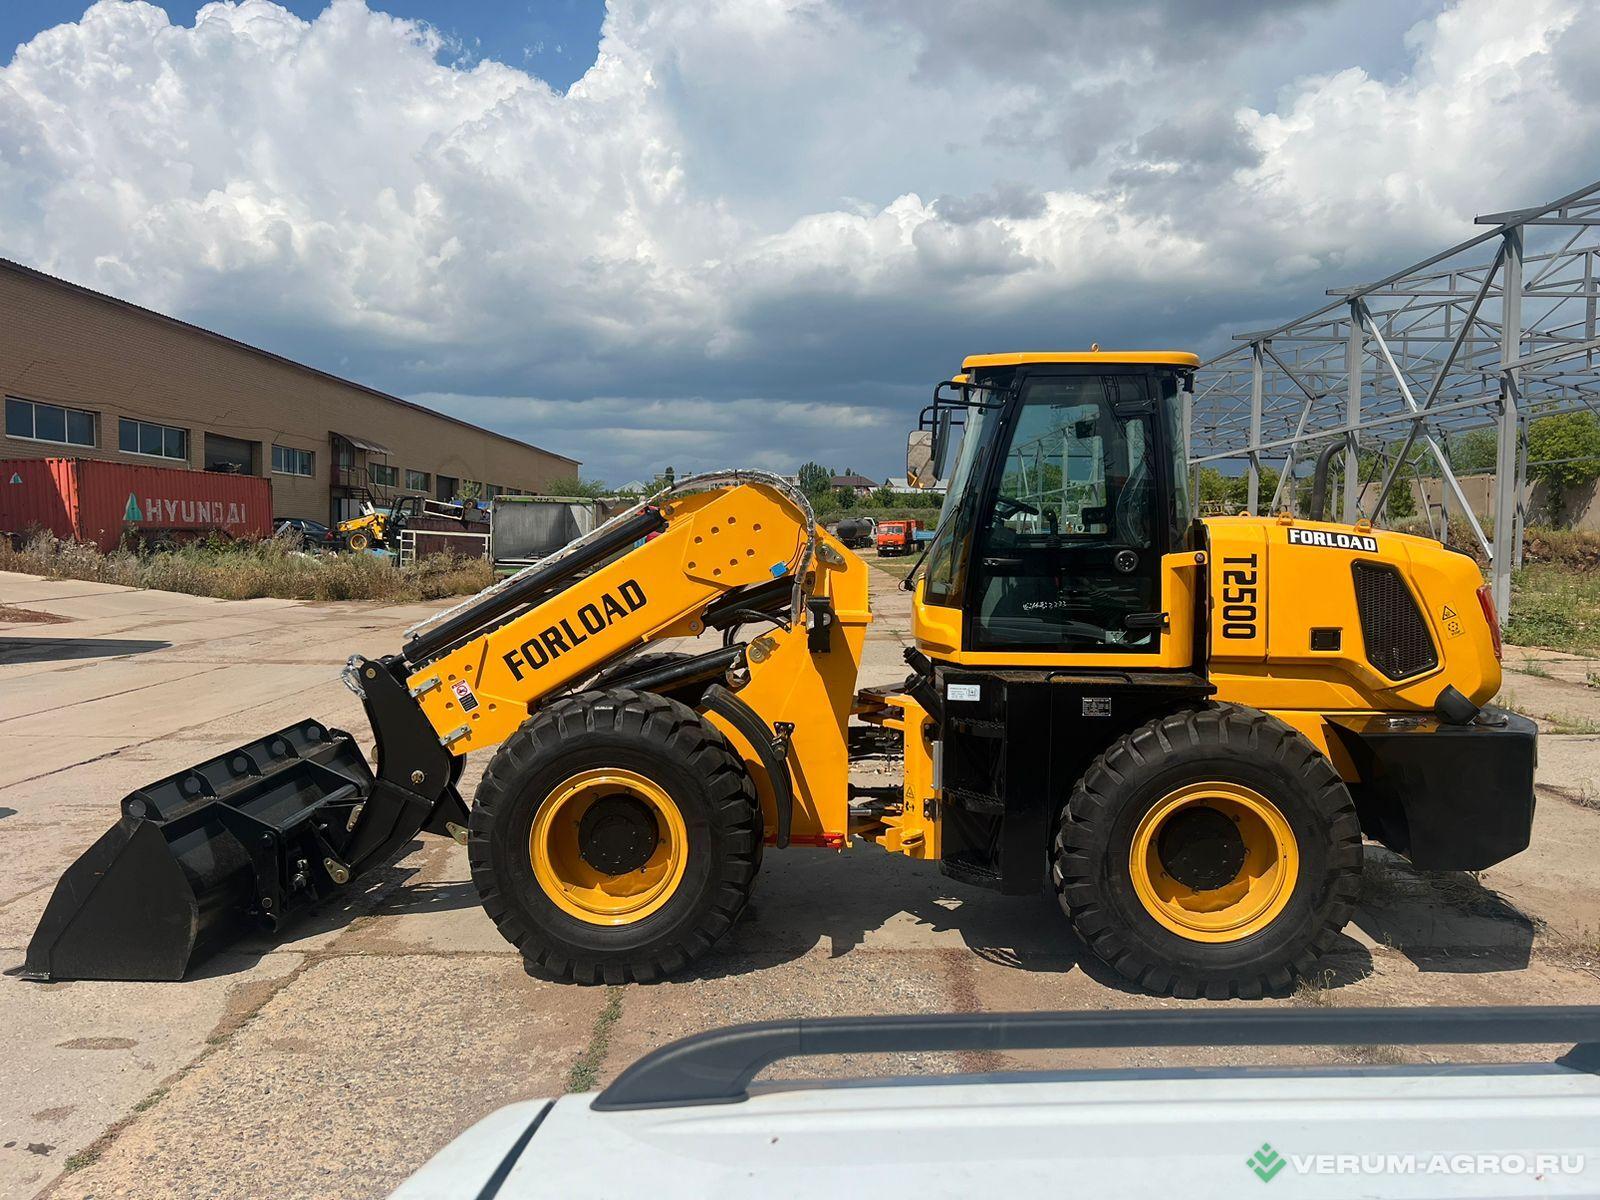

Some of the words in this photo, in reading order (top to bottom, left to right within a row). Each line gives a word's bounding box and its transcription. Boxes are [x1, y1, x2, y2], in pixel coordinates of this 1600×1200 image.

[145, 498, 246, 523] HYUNDAI
[1289, 529, 1377, 552] FORLOAD
[1222, 553, 1258, 640] T2500
[502, 578, 647, 682] FORLOAD
